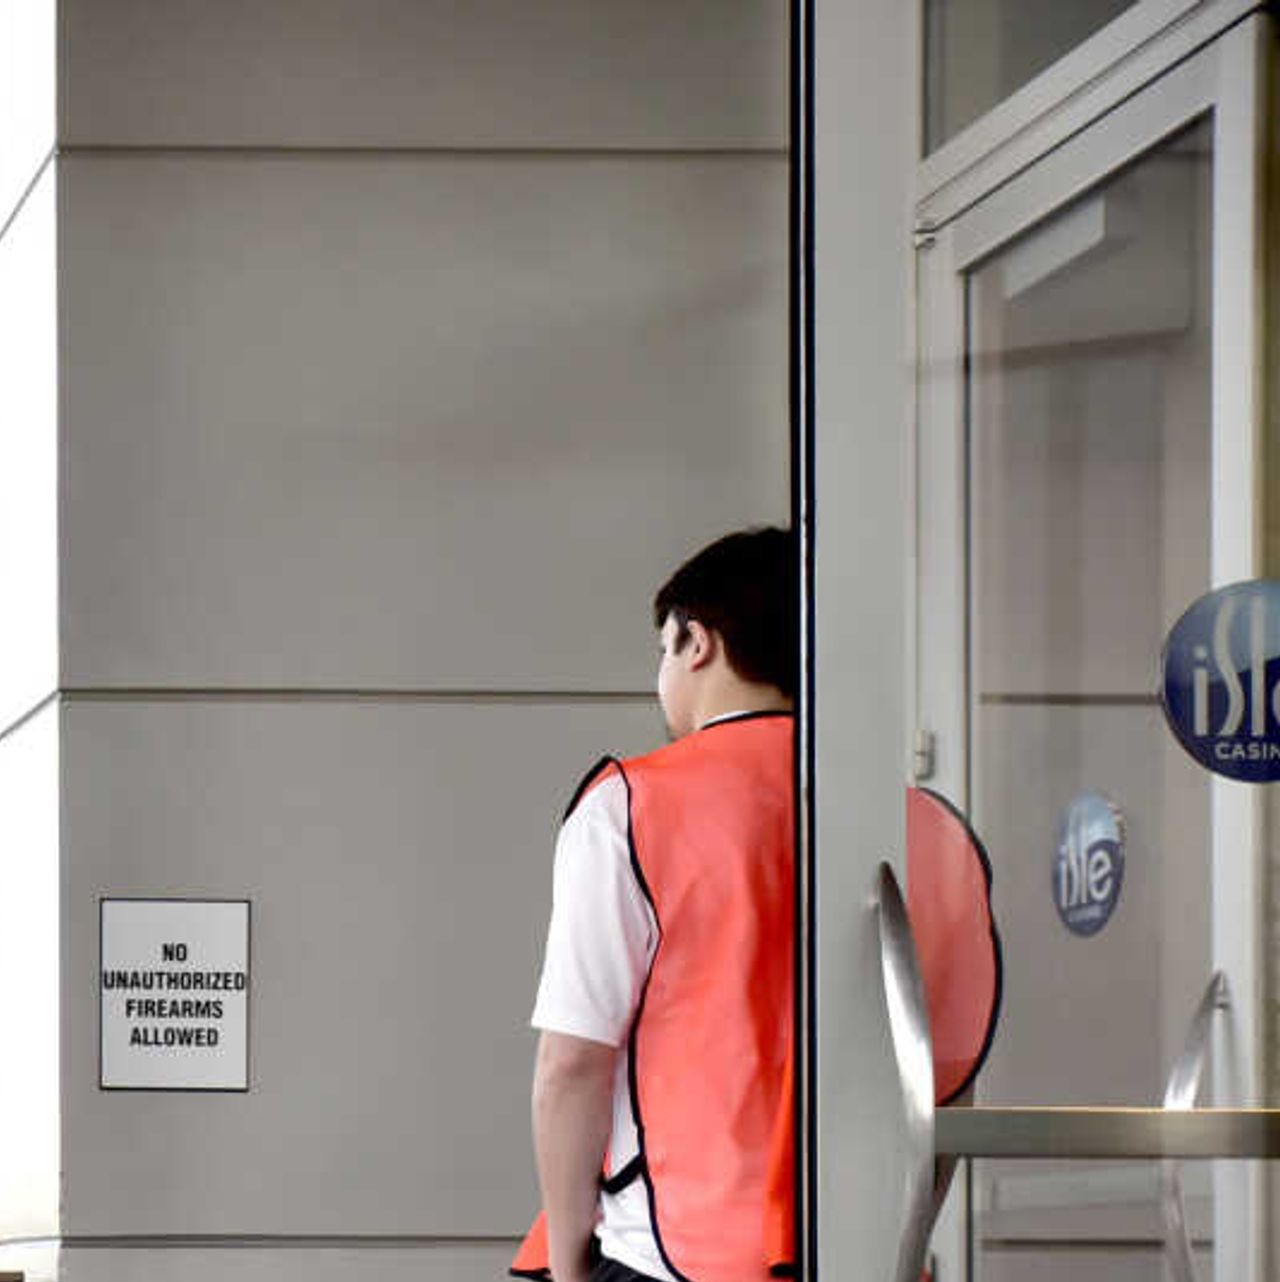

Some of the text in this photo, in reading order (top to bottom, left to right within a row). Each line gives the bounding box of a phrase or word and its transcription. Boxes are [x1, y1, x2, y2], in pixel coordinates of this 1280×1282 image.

[162, 943, 187, 961] NO
[103, 971, 245, 990] UNAUTHORIZED
[125, 999, 223, 1018] FIREARMS
[130, 1027, 218, 1046] ALLOWED
